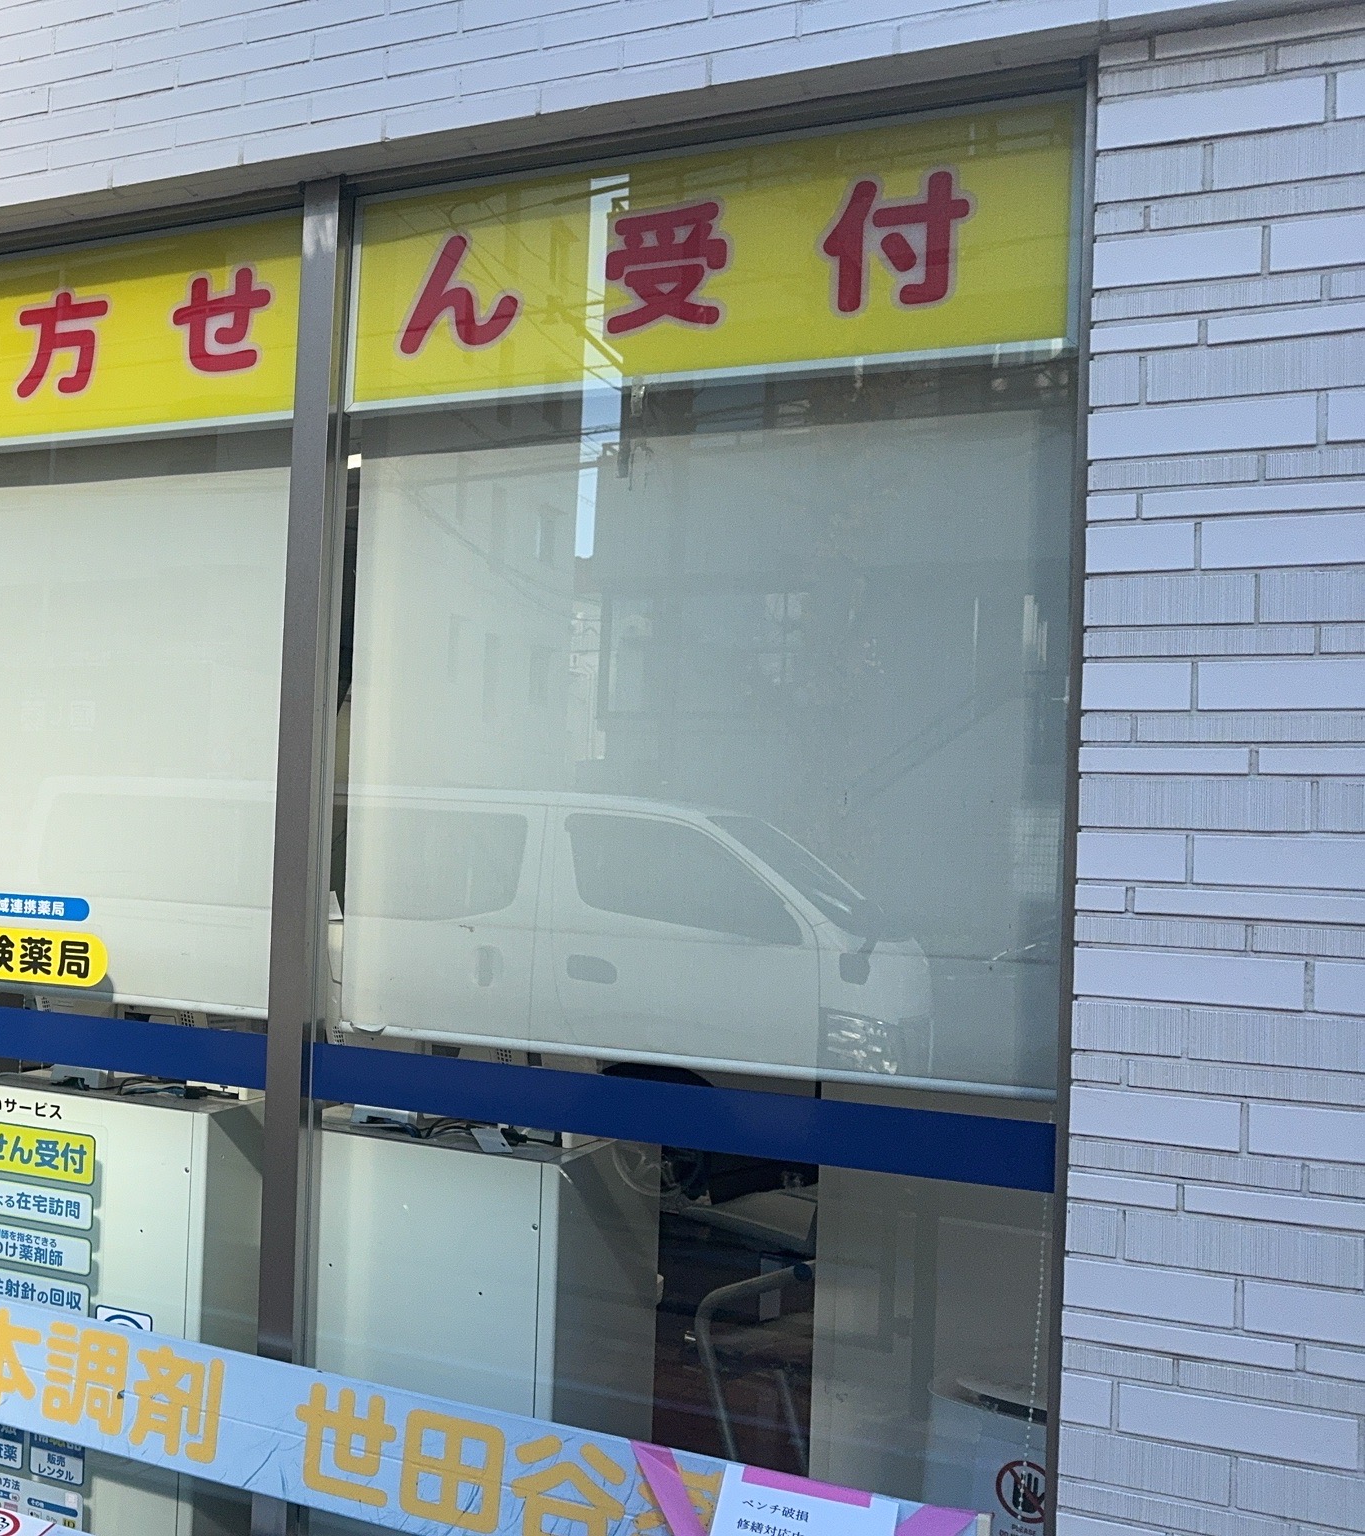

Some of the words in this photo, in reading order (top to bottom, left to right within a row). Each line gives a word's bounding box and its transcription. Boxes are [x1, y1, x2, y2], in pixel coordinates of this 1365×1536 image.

[47, 1453, 66, 1467] 販売
[38, 1464, 75, 1482] レンタル
